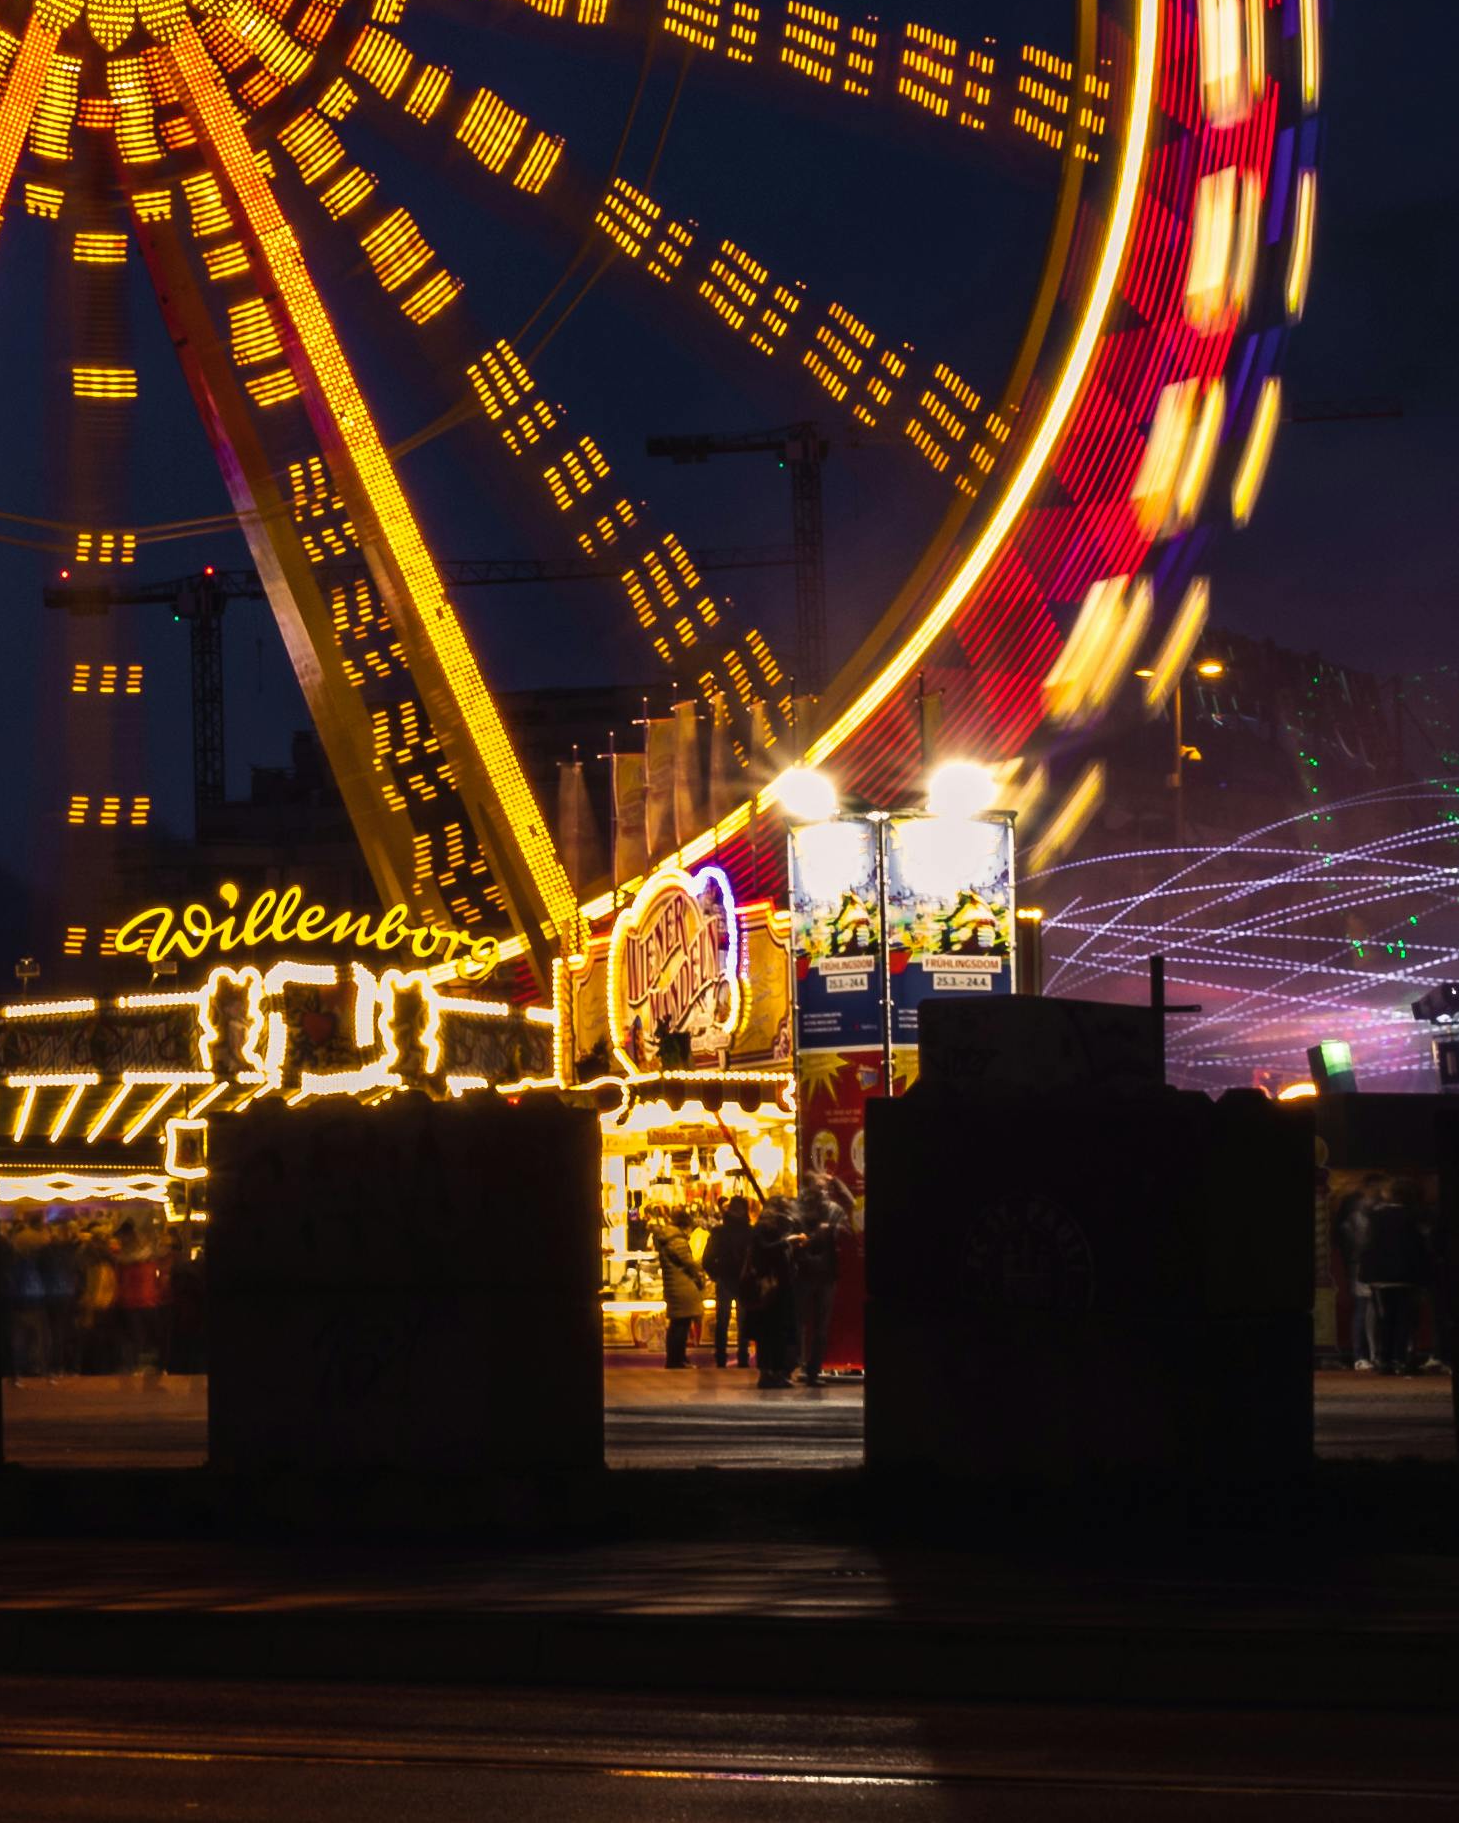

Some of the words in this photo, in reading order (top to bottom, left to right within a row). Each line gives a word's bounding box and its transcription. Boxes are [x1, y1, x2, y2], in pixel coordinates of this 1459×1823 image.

[114, 881, 501, 981] Willenborg
[626, 892, 689, 1004] WIENER
[925, 956, 999, 970] FRÜHLINGSDOM
[936, 977, 958, 987] 25.3.
[966, 977, 989, 987] 24.4.
